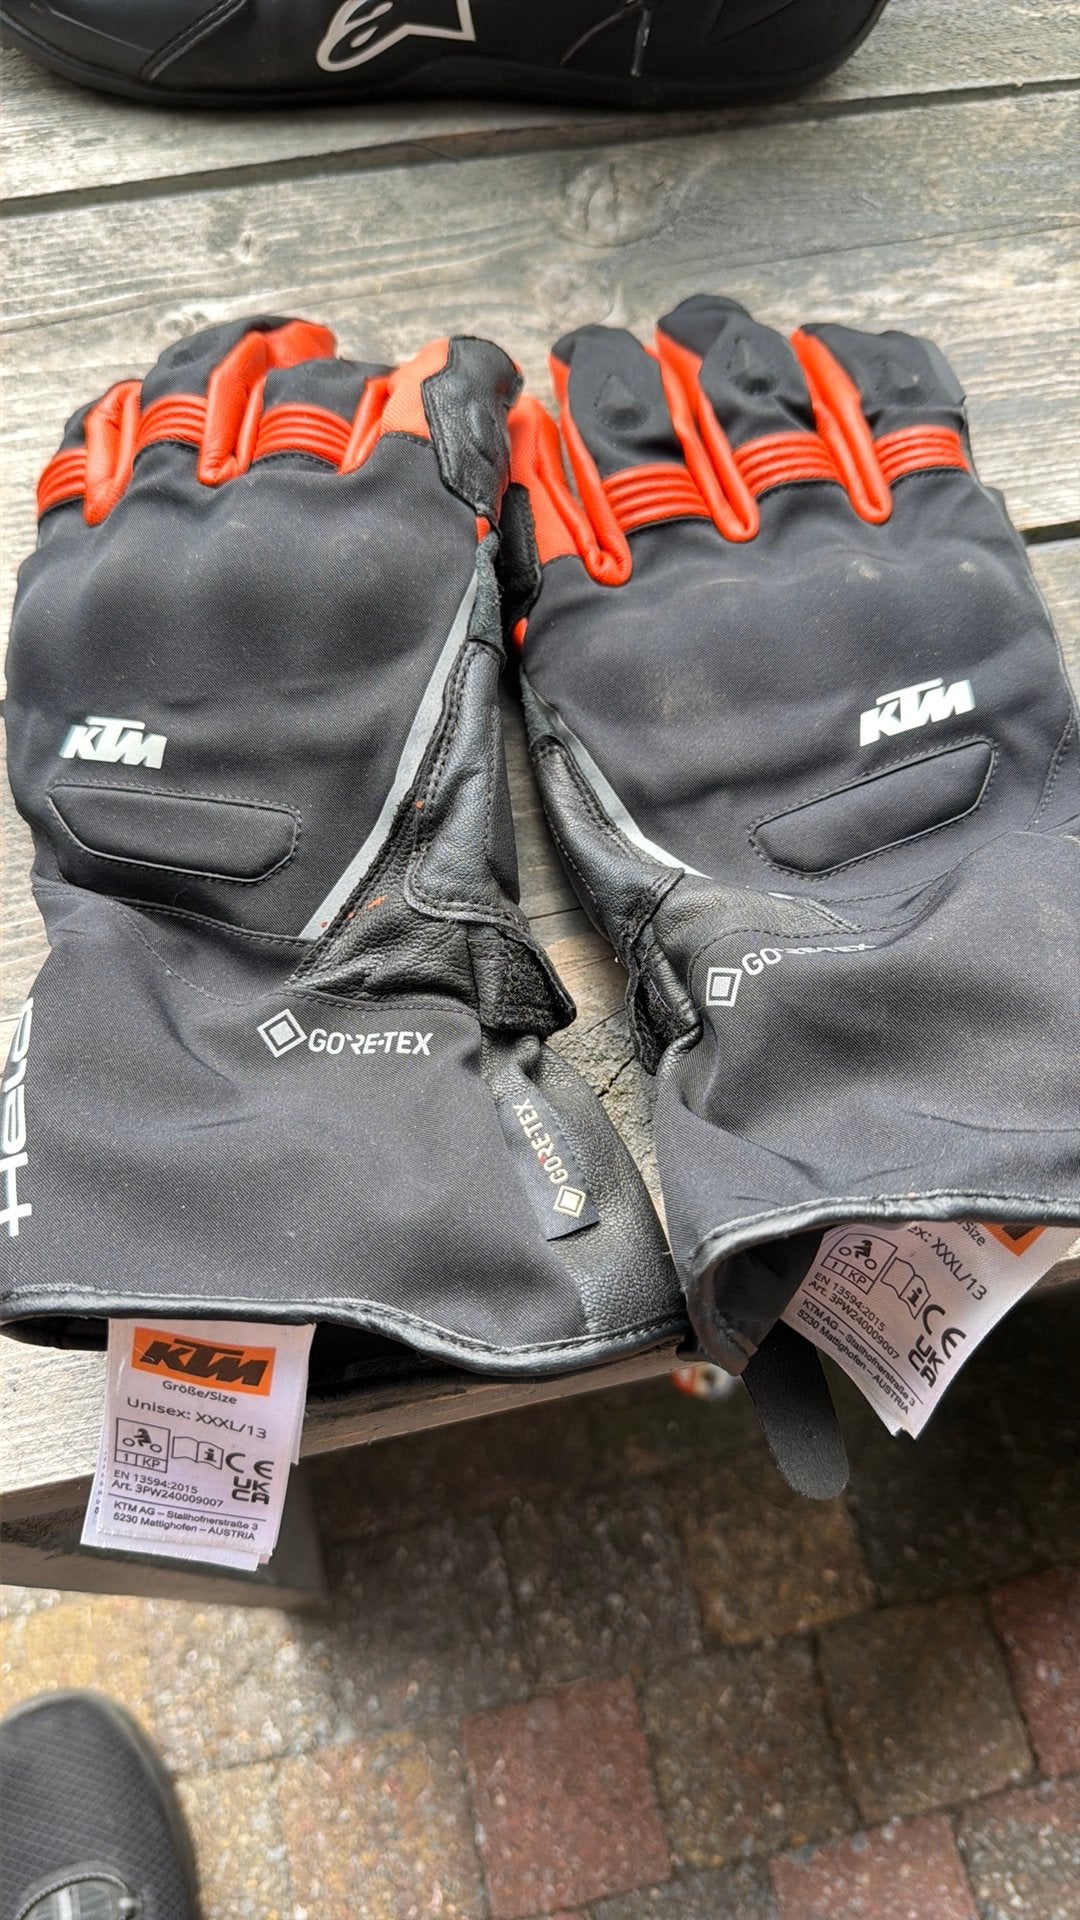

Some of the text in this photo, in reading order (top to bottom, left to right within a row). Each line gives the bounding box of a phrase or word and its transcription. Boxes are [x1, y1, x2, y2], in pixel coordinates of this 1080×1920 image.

[860, 677, 976, 747] KTM
[59, 716, 168, 769] KTM
[308, 1028, 434, 1056] GORE-TEX
[512, 1098, 569, 1185] GORE-TEX
[847, 1269, 867, 1285] KP
[930, 1236, 988, 1301] XXXL/13
[808, 1280, 900, 1360] Art. 3PW240009007
[814, 1272, 886, 1332] EN 13594:2015
[139, 1338, 269, 1387] KTM
[796, 1309, 820, 1329] 5230
[819, 1327, 867, 1370] Mattighofen
[872, 1373, 909, 1415] AUSTRIA
[802, 1298, 825, 1319] KTM
[822, 1317, 839, 1331] AG
[909, 1399, 916, 1407] 3
[162, 1380, 238, 1405] Größe/Size
[127, 1397, 267, 1439] Unisex: XXXL/13
[114, 1469, 198, 1494] EN 13594:2015
[142, 1456, 161, 1468] KP
[112, 1479, 224, 1508] Art. 3PW240009007
[114, 1500, 137, 1513] KTM
[138, 1505, 155, 1516] AG
[251, 1523, 258, 1531] 3
[113, 1512, 138, 1524] 5230
[140, 1516, 198, 1533] Mattighofen
[207, 1527, 255, 1541] AUSTRIA
